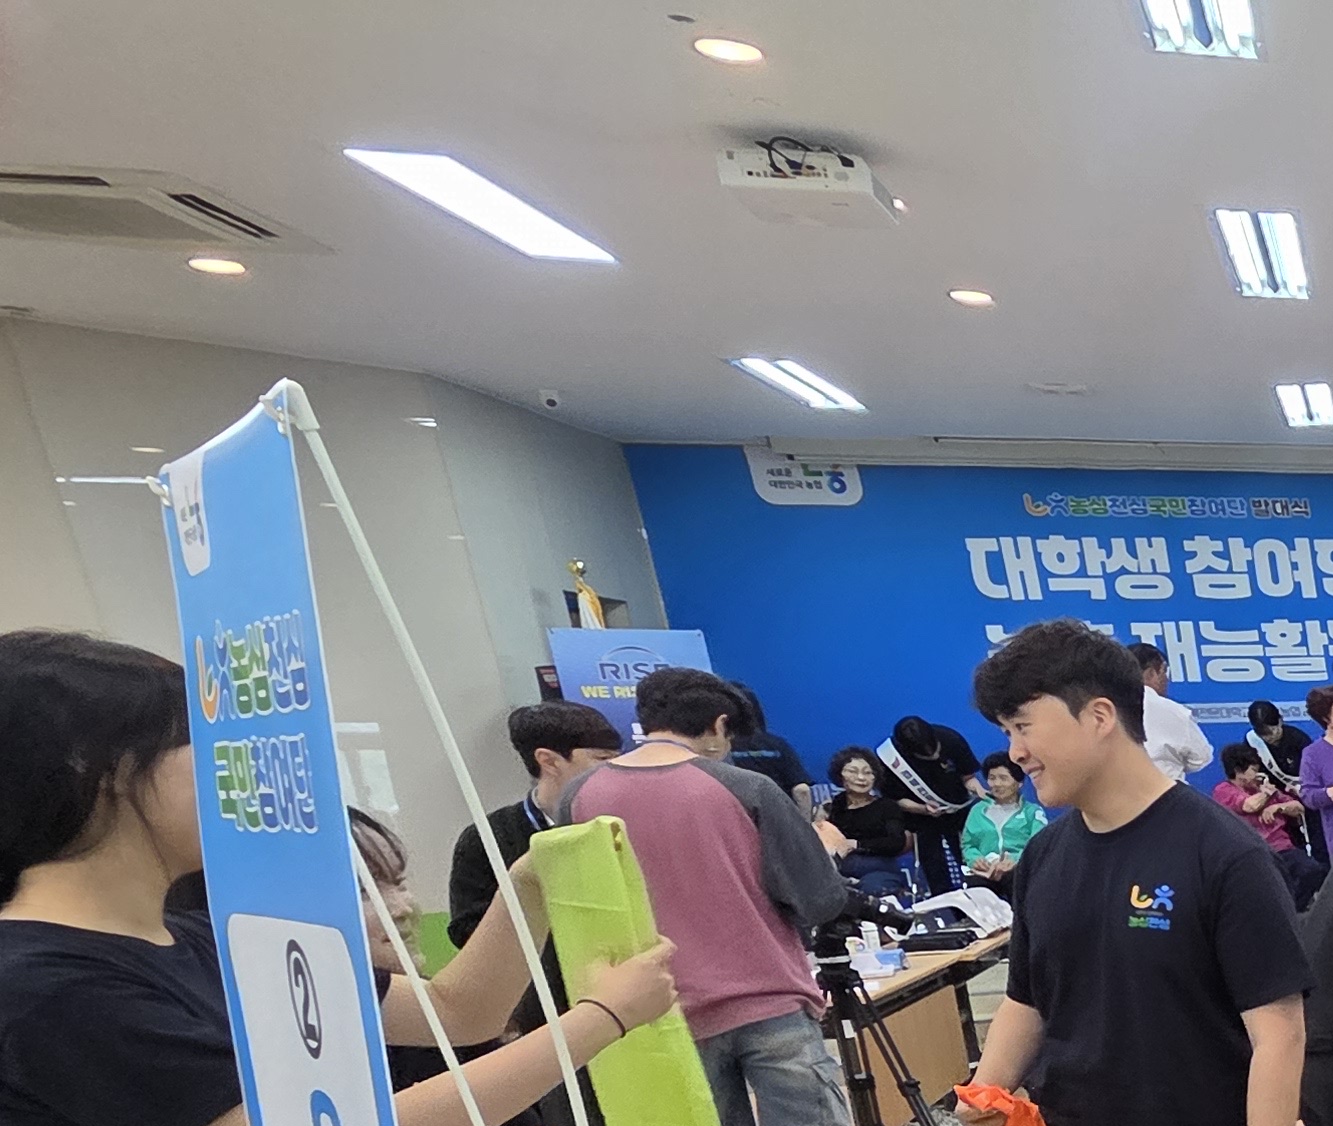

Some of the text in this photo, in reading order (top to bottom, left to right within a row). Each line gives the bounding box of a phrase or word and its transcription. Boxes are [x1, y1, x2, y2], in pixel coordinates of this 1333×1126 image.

[1251, 497, 1312, 519] 발대식
[964, 535, 1175, 601] 대학생
[581, 685, 611, 699] WE
